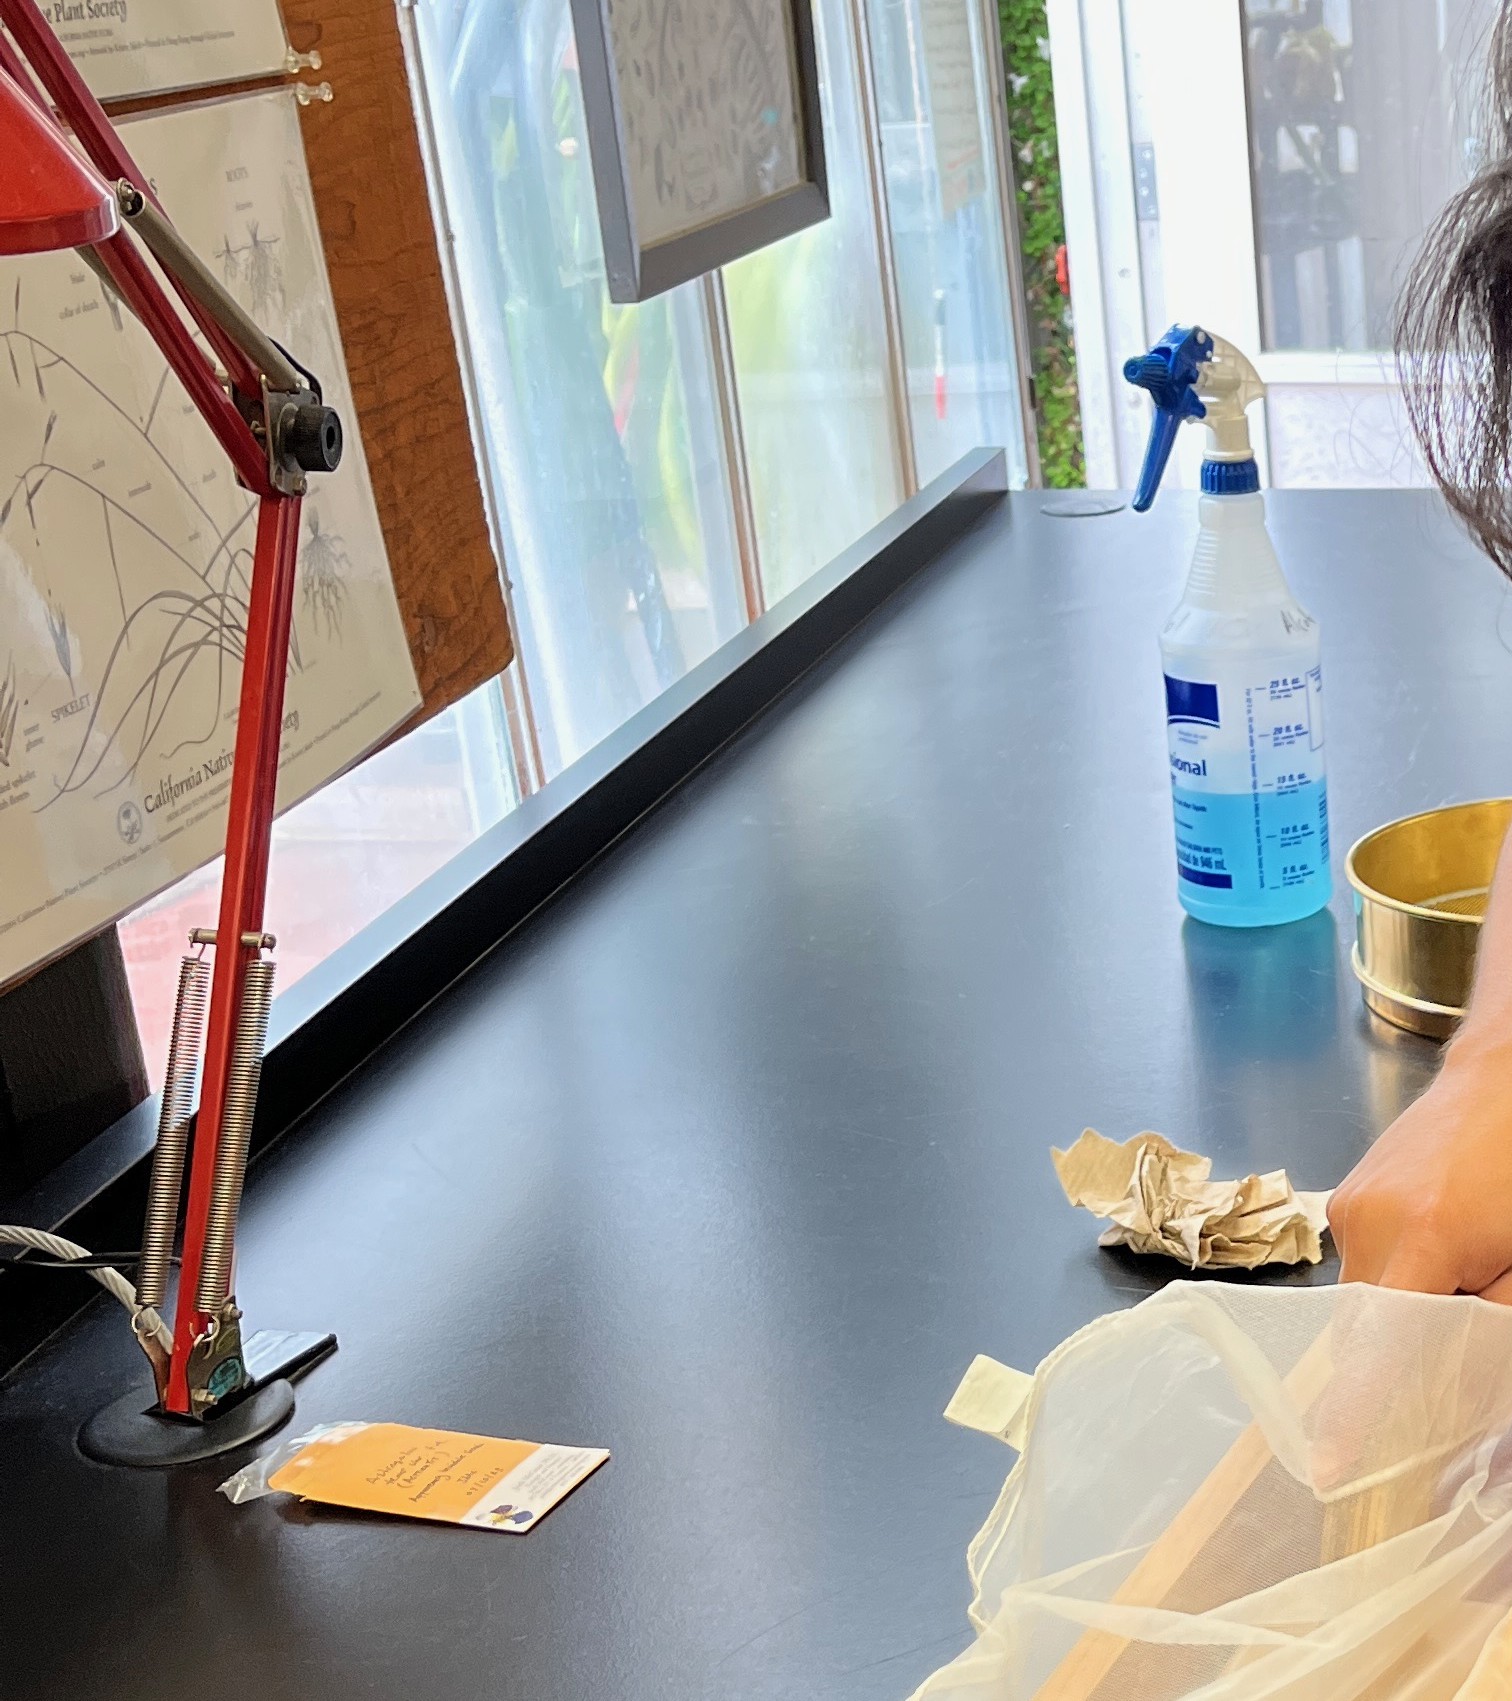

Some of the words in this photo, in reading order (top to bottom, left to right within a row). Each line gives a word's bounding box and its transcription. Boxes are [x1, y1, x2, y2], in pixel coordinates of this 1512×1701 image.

[55, 1, 84, 22] Plant
[88, 0, 127, 22] Society
[143, 767, 203, 813] California
[203, 748, 235, 782] Nativ
